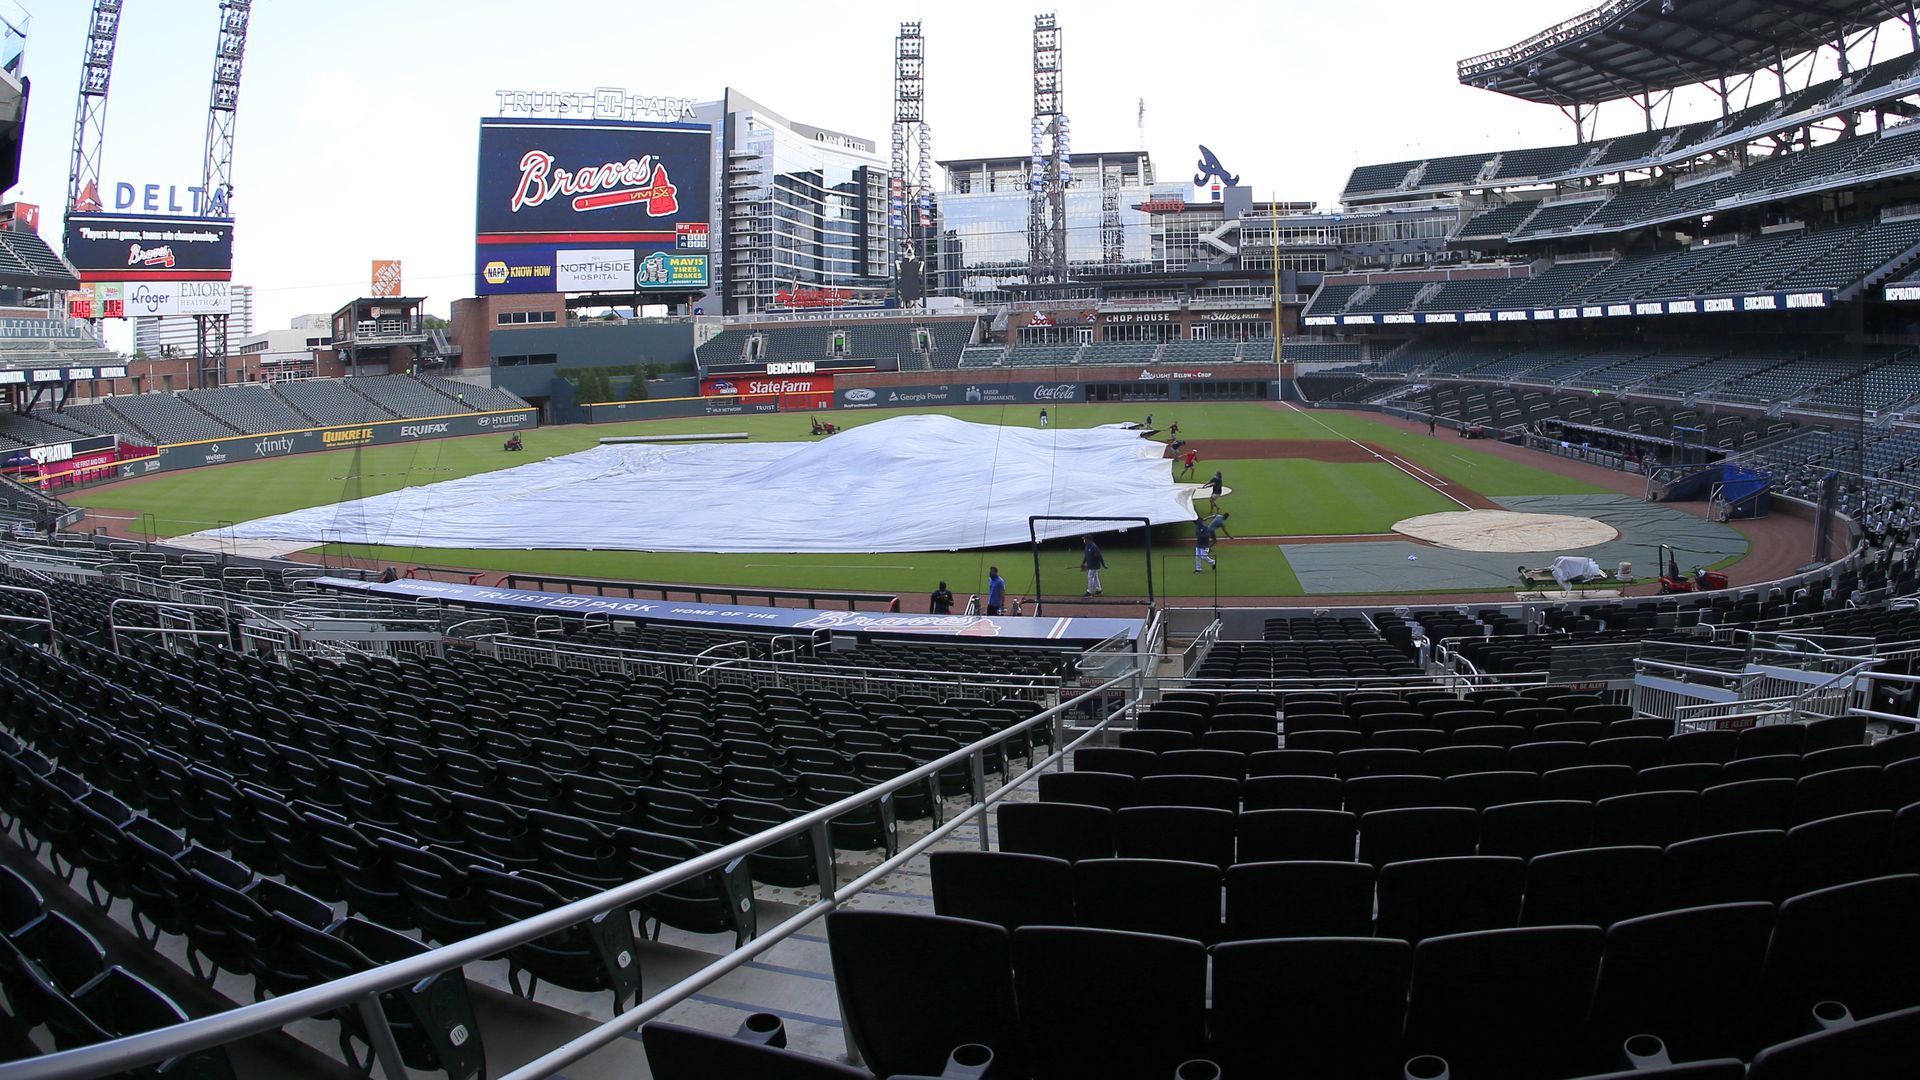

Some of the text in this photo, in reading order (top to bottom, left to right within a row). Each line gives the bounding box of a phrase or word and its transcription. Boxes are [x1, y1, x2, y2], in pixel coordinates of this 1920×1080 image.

[496, 90, 697, 118] TRUIST PARK
[511, 150, 651, 213] Braves
[115, 182, 228, 214] DELTA
[128, 244, 170, 266] Braves
[488, 266, 551, 278] NAPA KNOW HOW
[560, 262, 631, 272] NORTHSIDE
[181, 282, 229, 297] EMORY
[132, 284, 170, 312] Kroger
[1744, 296, 1776, 310] EDUCATION.
[1786, 292, 1825, 308] MOTIVATION.
[74, 300, 122, 312] 106 113
[766, 362, 816, 375] DEDICATION
[749, 381, 780, 394] State
[781, 381, 811, 393] Farm
[900, 393, 926, 401] Georgia
[492, 414, 527, 424] HYUNDAI
[322, 428, 374, 442] QUIKRETE
[400, 422, 449, 438] EQUIFAX
[30, 443, 73, 464] INSPIRATION
[254, 436, 294, 456] xfinity
[473, 590, 554, 604] TRUIST
[586, 600, 659, 612] PARK
[670, 607, 712, 616] HOME
[714, 609, 735, 617] OF
[746, 612, 779, 620] THE
[792, 610, 976, 628] Braves
[1733, 719, 1754, 728] ALERT
[454, 1030, 464, 1042] 10
